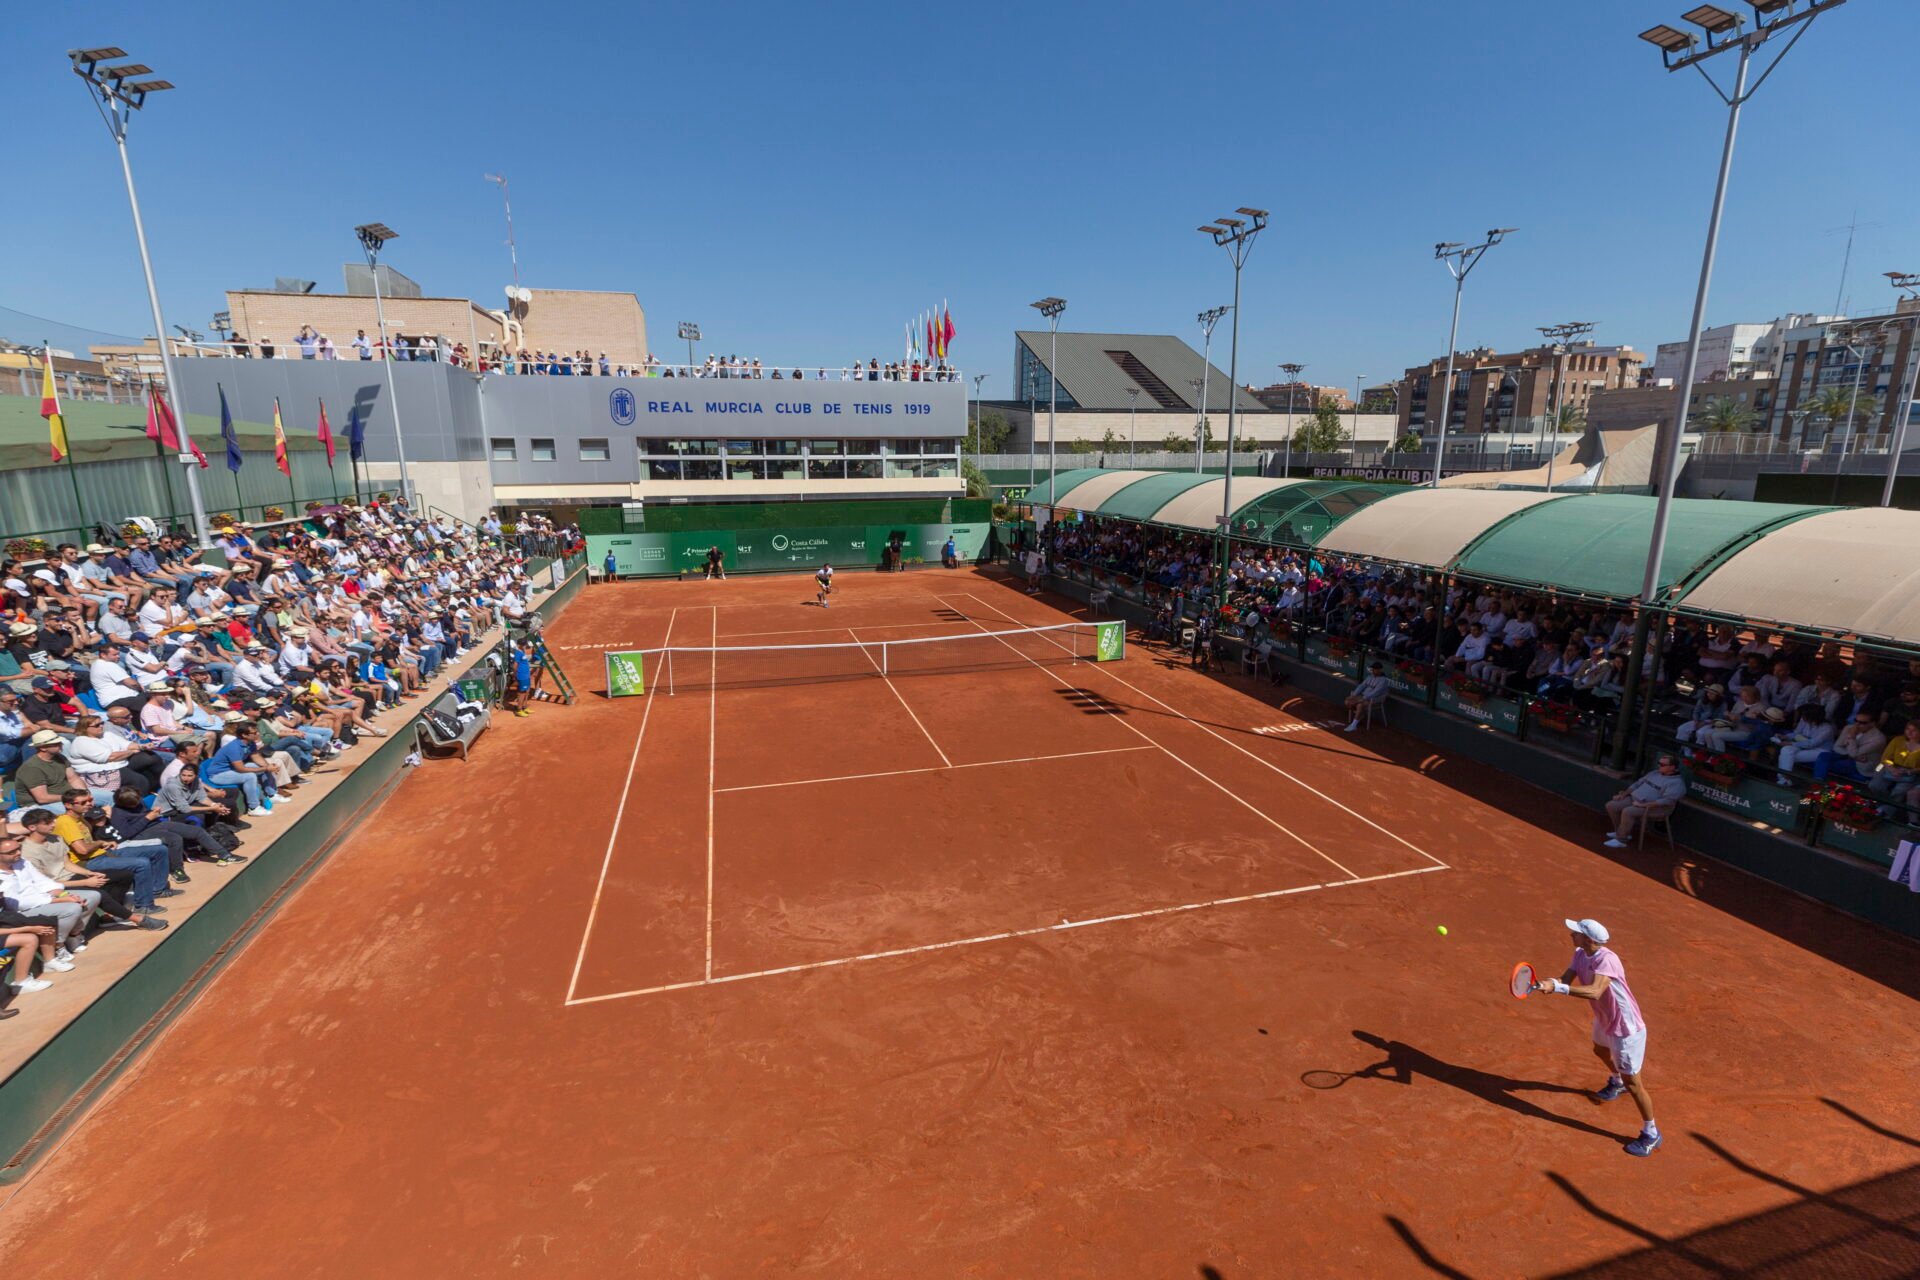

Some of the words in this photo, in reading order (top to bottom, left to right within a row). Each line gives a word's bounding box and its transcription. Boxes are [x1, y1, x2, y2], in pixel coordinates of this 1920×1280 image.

[648, 400, 694, 413] REAL
[705, 401, 764, 414] MURCIA
[775, 402, 812, 415] CLUB
[823, 403, 842, 414] DE
[853, 403, 893, 414] TENIS
[903, 403, 932, 415] 1919
[1313, 468, 1337, 479] REAL
[1341, 468, 1383, 480] MURCIA
[1387, 470, 1420, 484] CLUB
[808, 538, 828, 546] Cálida
[560, 642, 633, 650] MURCIA
[621, 660, 641, 684] ATP
[1458, 702, 1494, 720] ESTRELLA
[433, 717, 457, 738] HEAD
[1251, 719, 1346, 734] MURCIA
[1690, 781, 1751, 808] ESTRELLA
